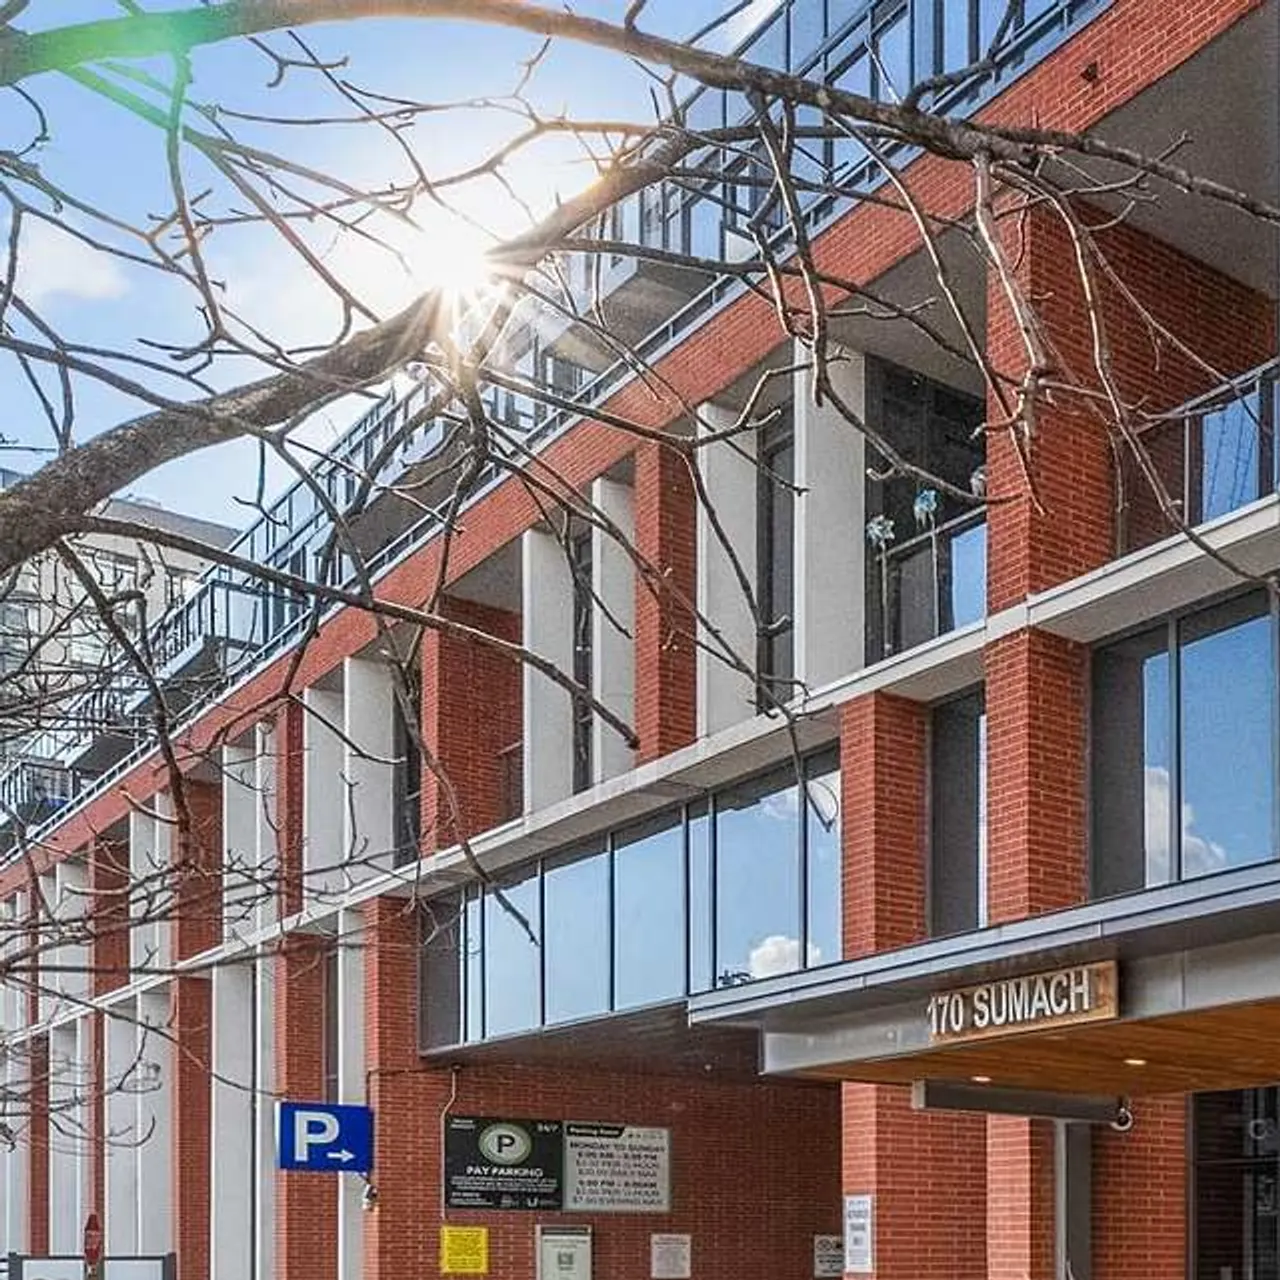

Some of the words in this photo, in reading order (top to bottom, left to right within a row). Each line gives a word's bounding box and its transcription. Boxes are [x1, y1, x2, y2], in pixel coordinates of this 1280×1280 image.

[927, 993, 963, 1034] 170
[974, 967, 1089, 1028] SUMACH
[294, 1110, 340, 1162] P
[496, 1134, 516, 1154] P
[466, 1165, 491, 1175] PAY
[492, 1166, 544, 1177] PARKING
